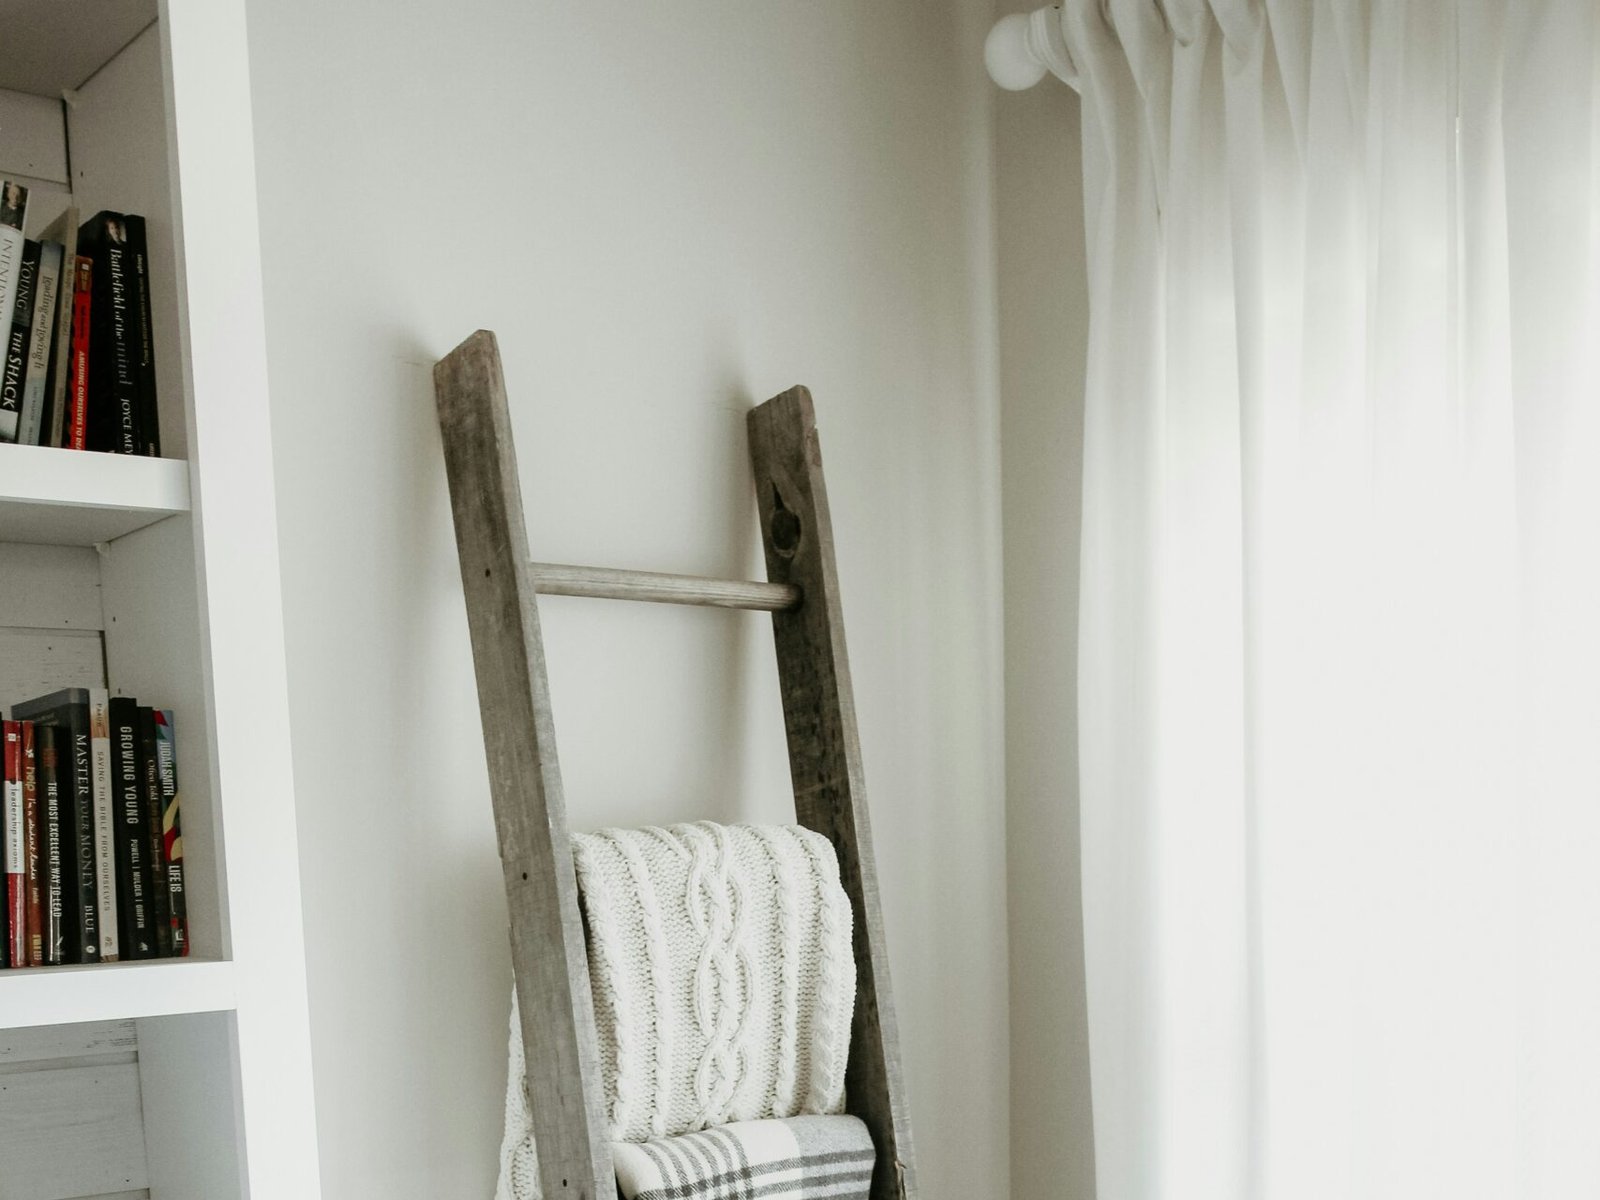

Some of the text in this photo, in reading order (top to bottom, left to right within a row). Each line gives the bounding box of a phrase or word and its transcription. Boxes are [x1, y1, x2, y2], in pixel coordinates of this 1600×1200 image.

[17, 260, 35, 310] YOUNG
[38, 276, 54, 315] Leading
[110, 248, 126, 310] Battlefield
[115, 311, 124, 323] of
[116, 324, 125, 340] the
[32, 328, 49, 360] Loving
[2, 332, 23, 408] THE SHACK
[78, 351, 86, 386] AMUSING
[76, 386, 84, 426] OURSELVES
[120, 398, 132, 430] JOYCE
[76, 426, 82, 436] TO
[24, 766, 36, 792] help
[120, 726, 140, 825] GROWING YOUNG
[159, 742, 174, 796] JUDAH SMITH
[10, 788, 19, 834] leadership
[76, 734, 94, 889] MASTER YOUR MONEY
[48, 782, 62, 918] THE MOST EXCELLENT WAY TO LEAD
[98, 786, 106, 801] THE
[102, 862, 110, 912] OURSELVES
[130, 839, 139, 864] POWELL
[133, 872, 142, 897] MULDER
[168, 865, 182, 892] LIFE IS
[84, 905, 94, 934] BLUE
